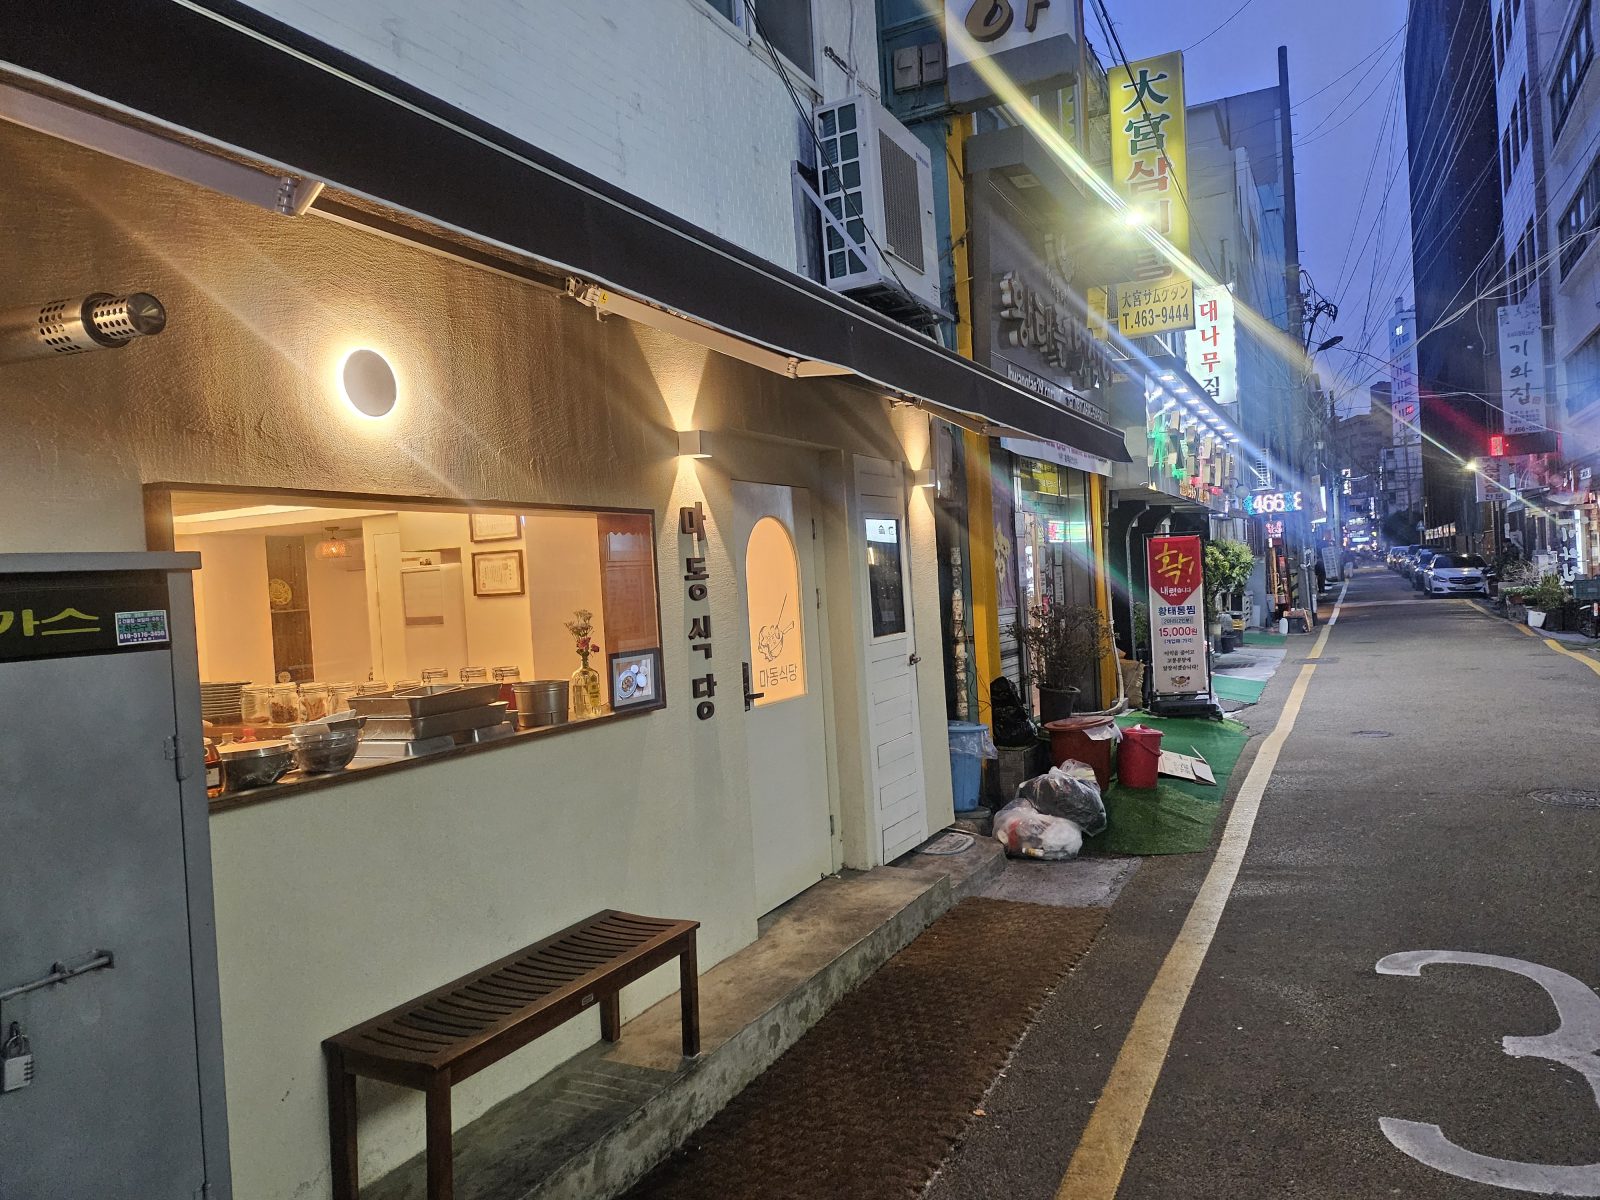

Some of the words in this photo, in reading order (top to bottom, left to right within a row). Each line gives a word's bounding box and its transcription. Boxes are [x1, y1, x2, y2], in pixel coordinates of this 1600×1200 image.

[1122, 303, 1190, 330] T.463-9444
[1199, 299, 1221, 397] 대나무집
[1509, 339, 1533, 405] 기와집
[1154, 542, 1195, 585] 확!
[679, 501, 717, 720] 마동식당
[1158, 605, 1196, 617] 황태통찜
[1158, 626, 1198, 638] 15,000원
[758, 662, 798, 689] 마동식당
